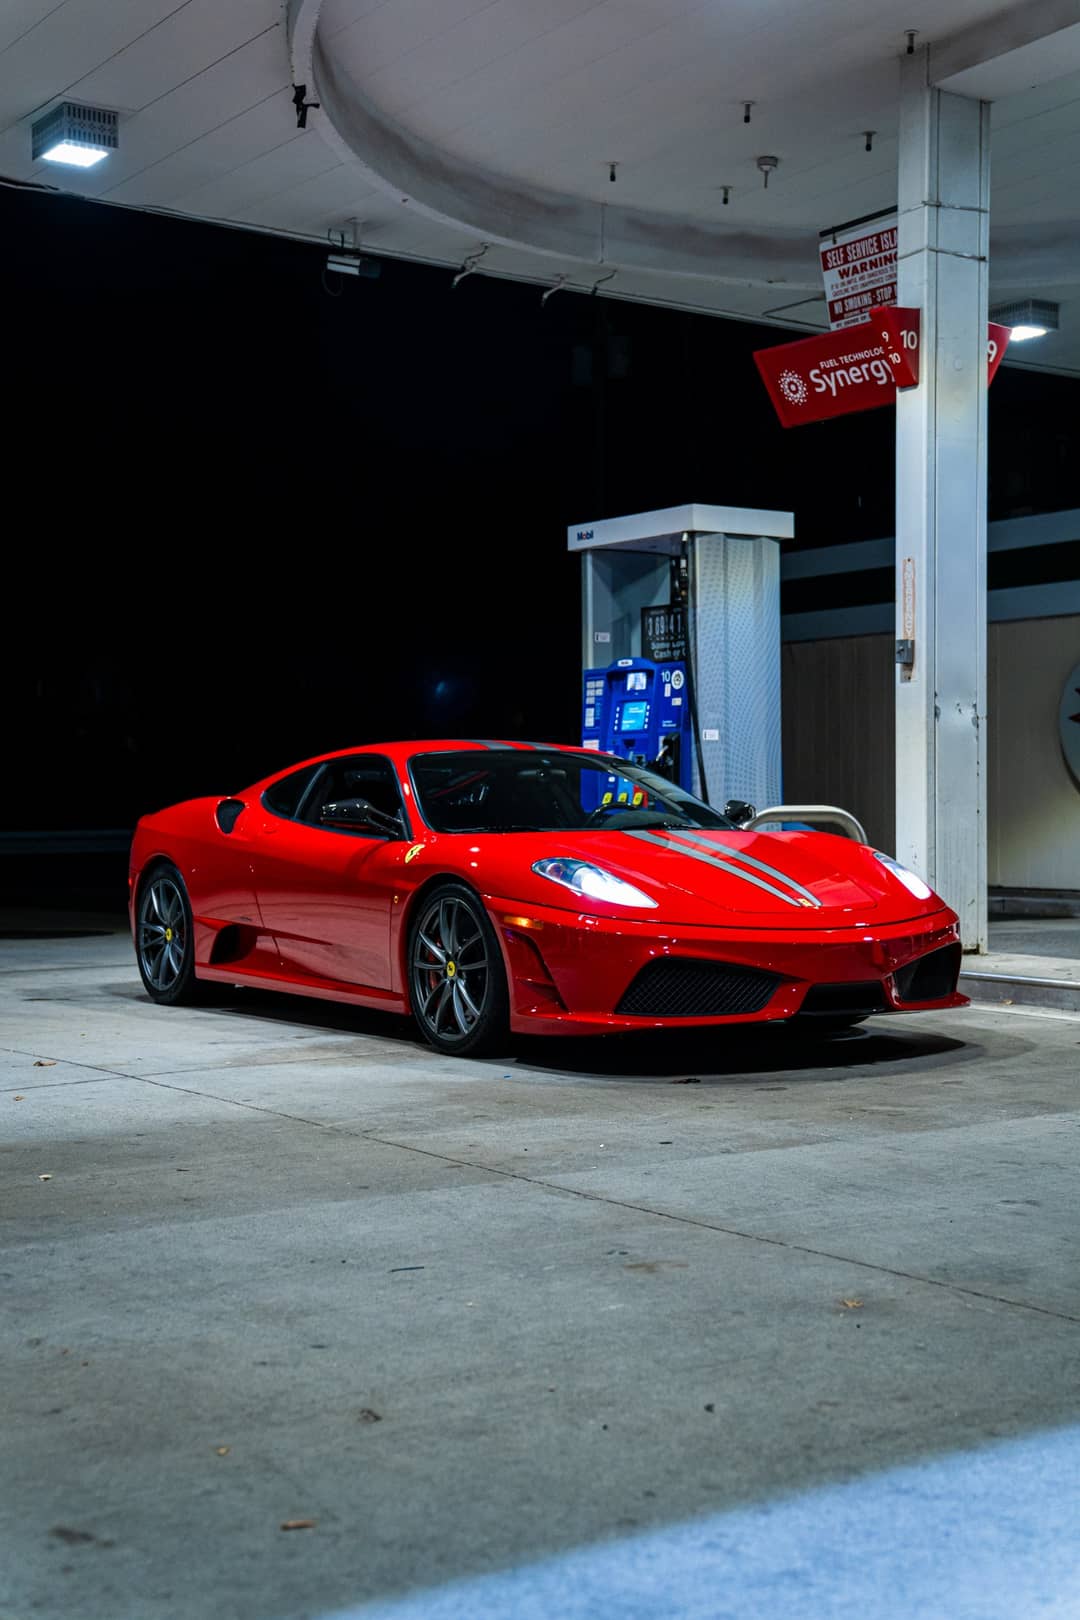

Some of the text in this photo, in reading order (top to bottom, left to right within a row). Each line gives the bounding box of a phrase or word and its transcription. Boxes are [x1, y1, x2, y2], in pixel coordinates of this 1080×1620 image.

[826, 248, 844, 268] SELF
[846, 236, 879, 262] SERVICE
[833, 301, 843, 315] NO
[844, 291, 873, 312] SMOKING
[876, 286, 893, 302] STOP
[881, 331, 889, 342] 9
[899, 329, 918, 350] 10
[988, 340, 998, 363] 9
[819, 358, 840, 370] FUEL
[888, 352, 902, 365] 10
[576, 530, 595, 541] Mobil
[661, 670, 671, 683] 10
